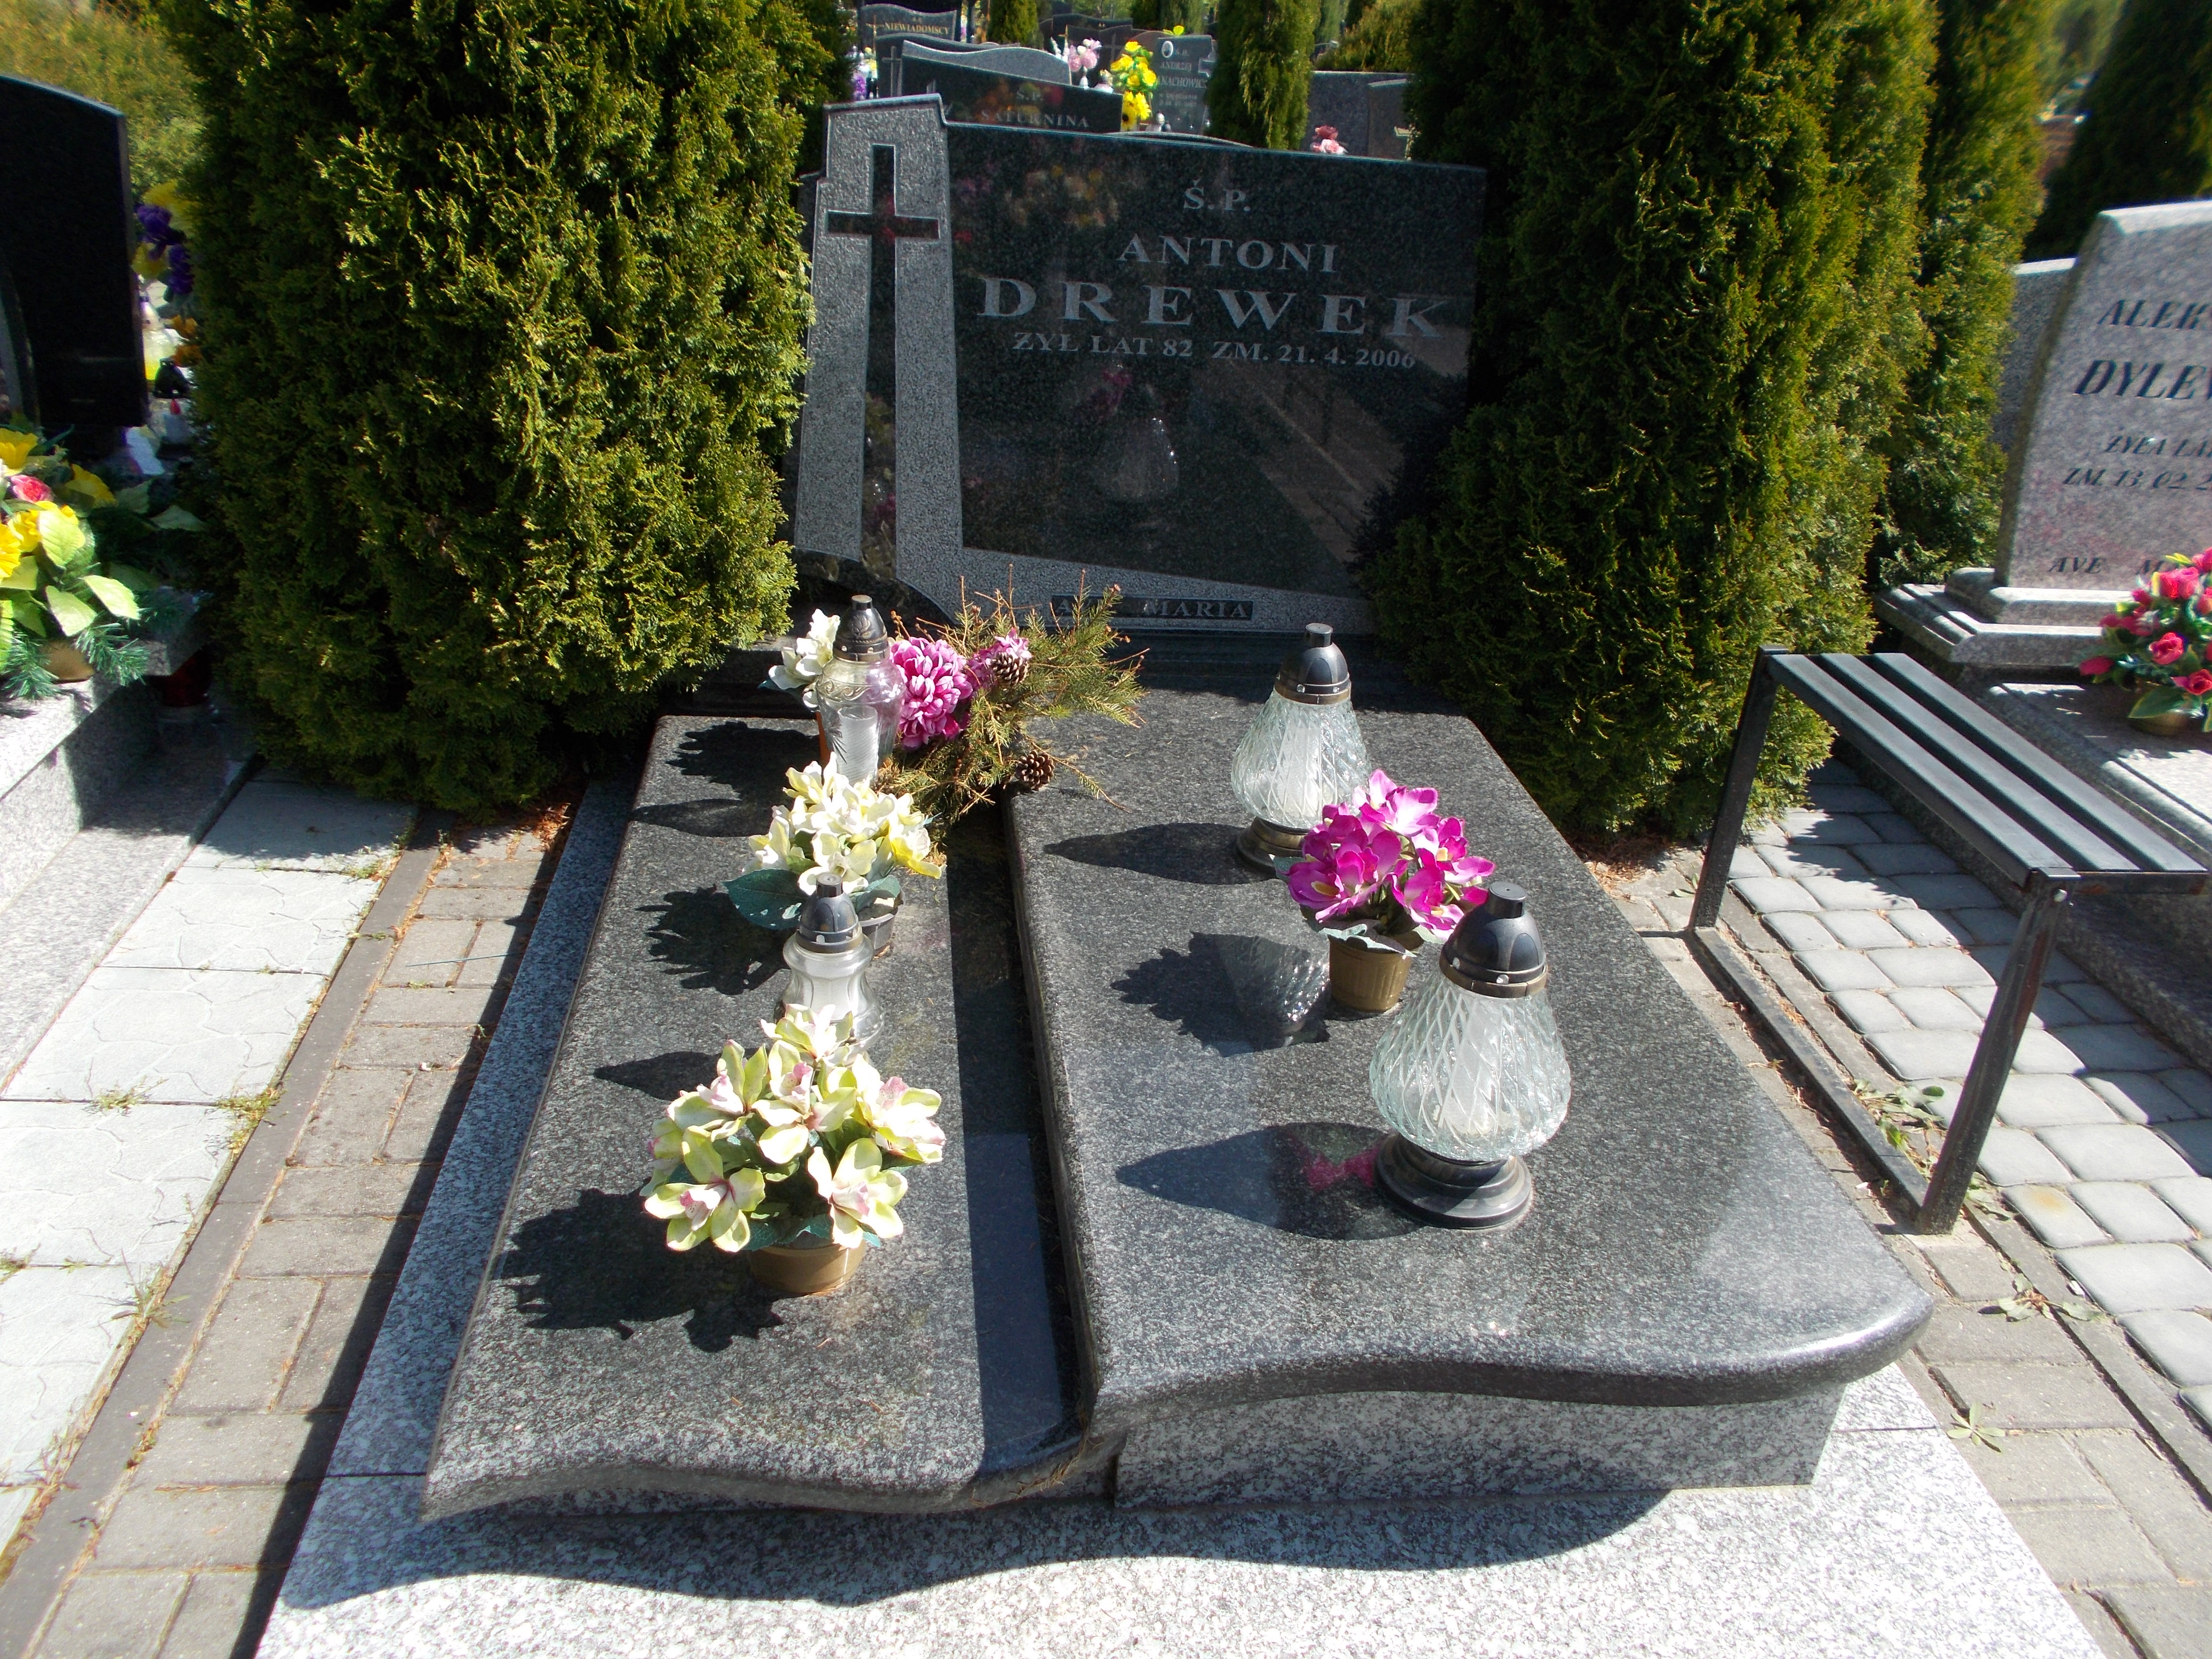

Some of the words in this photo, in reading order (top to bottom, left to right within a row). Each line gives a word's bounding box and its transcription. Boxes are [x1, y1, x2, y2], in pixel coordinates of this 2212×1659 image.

[885, 22, 950, 35] NIEWIADOMSCY
[981, 109, 1089, 128] SATURNINA
[1116, 233, 1338, 273] ANTONI
[977, 276, 1449, 338] DREWEK
[2097, 299, 2212, 330] ALEK
[1090, 335, 1153, 355] LAT
[1162, 338, 1193, 358] 82
[1211, 341, 1269, 361] ZM.
[1355, 349, 1416, 369] 2006
[2072, 360, 2212, 400] DYLE
[2173, 438, 2212, 457] LA
[2048, 556, 2104, 574] AVE
[1142, 599, 1248, 618] MARIA
